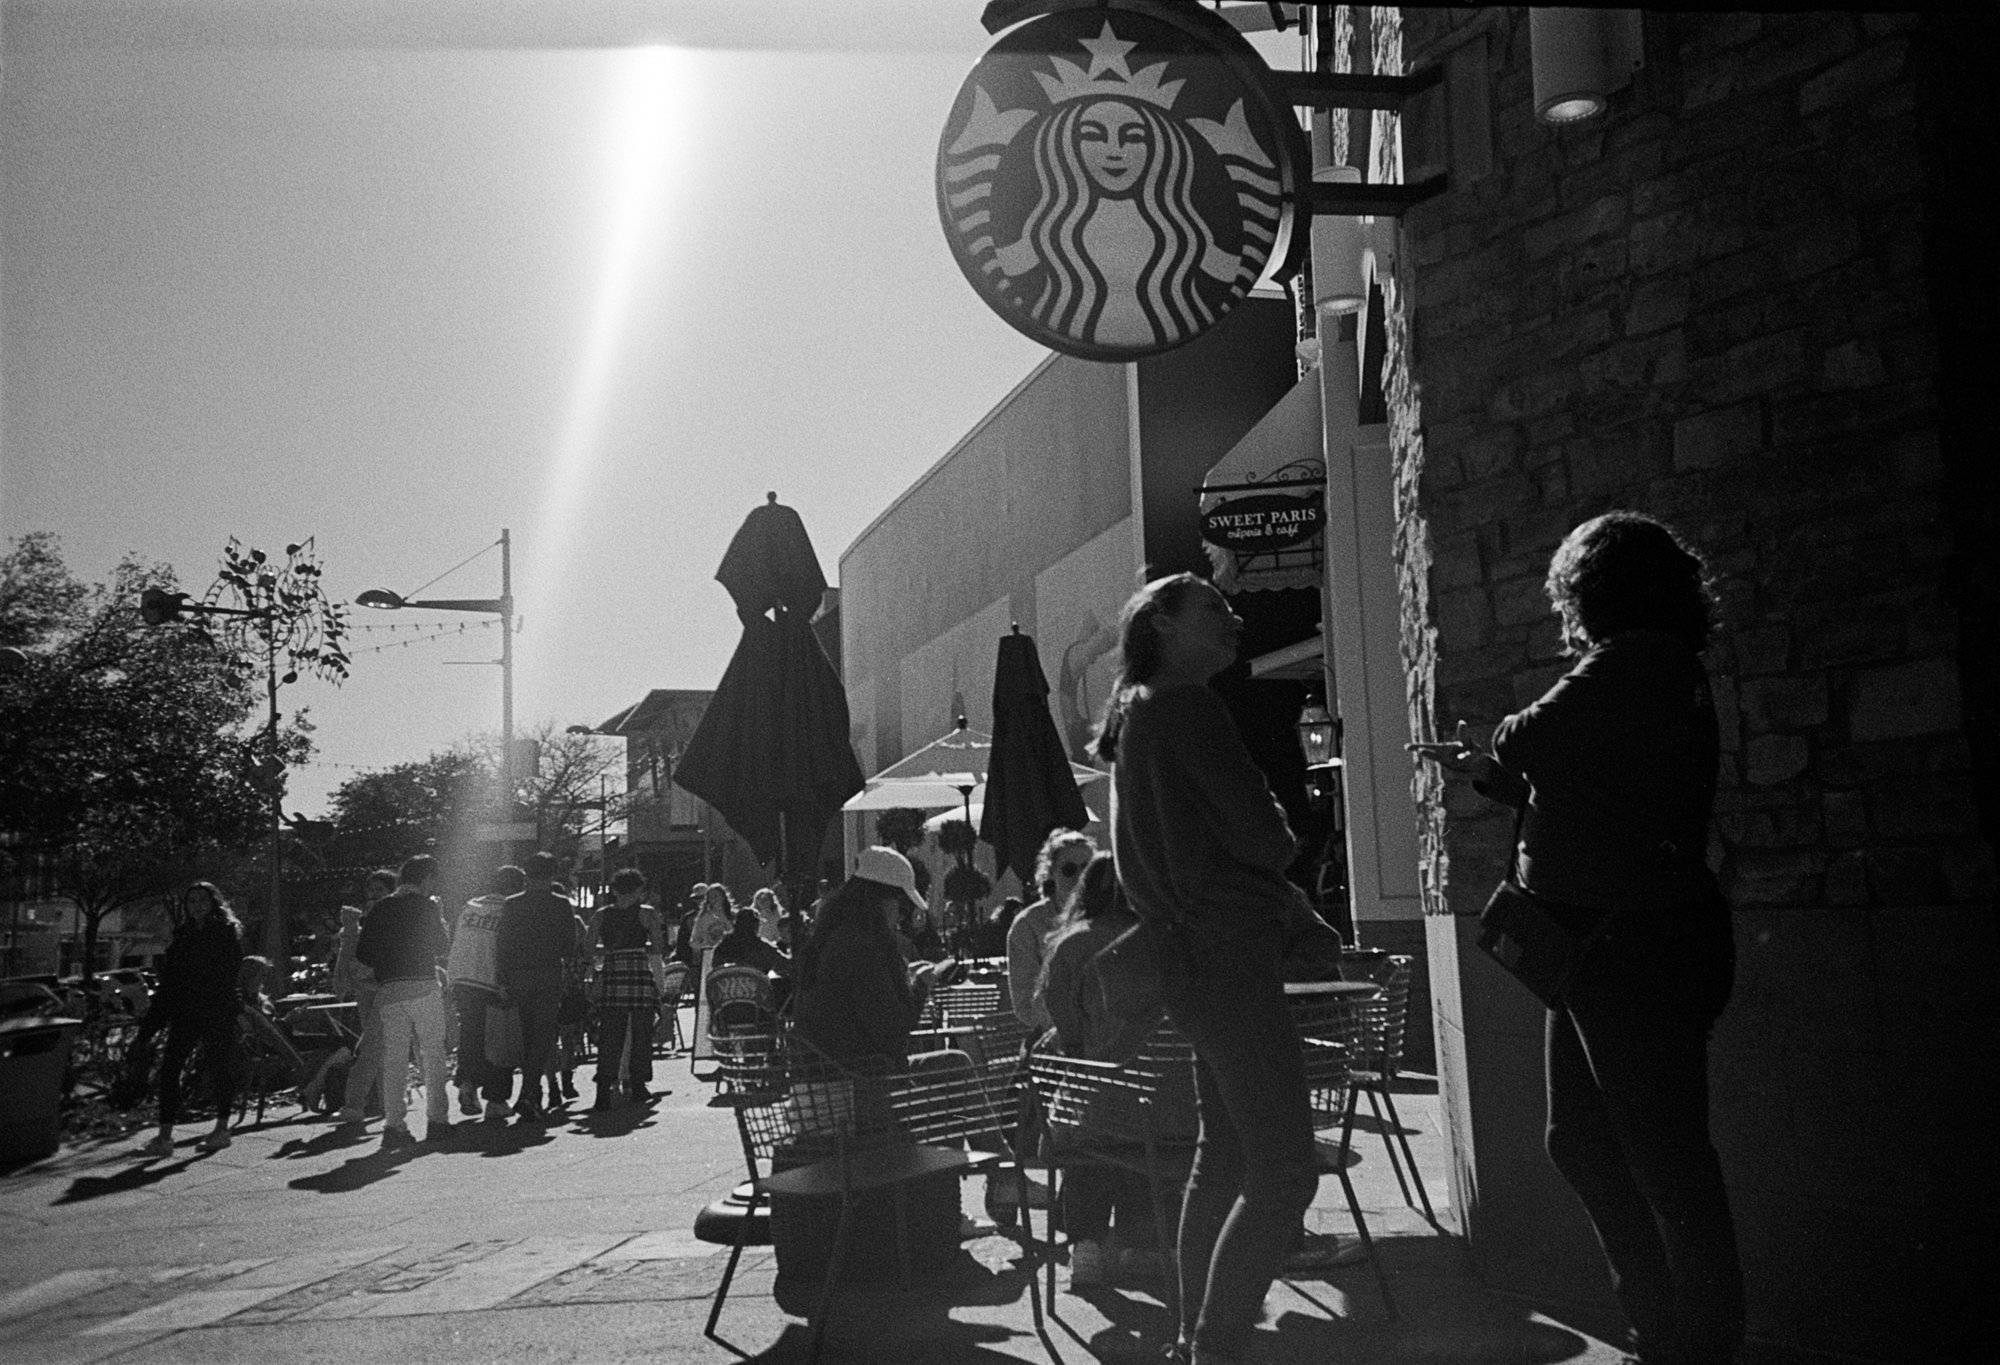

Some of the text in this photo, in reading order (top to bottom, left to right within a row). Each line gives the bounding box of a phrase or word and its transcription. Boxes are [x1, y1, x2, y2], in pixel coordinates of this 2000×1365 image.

[1209, 509, 1316, 528] SWEET PARIS
[1265, 524, 1272, 535] &
[1276, 523, 1299, 537] café
